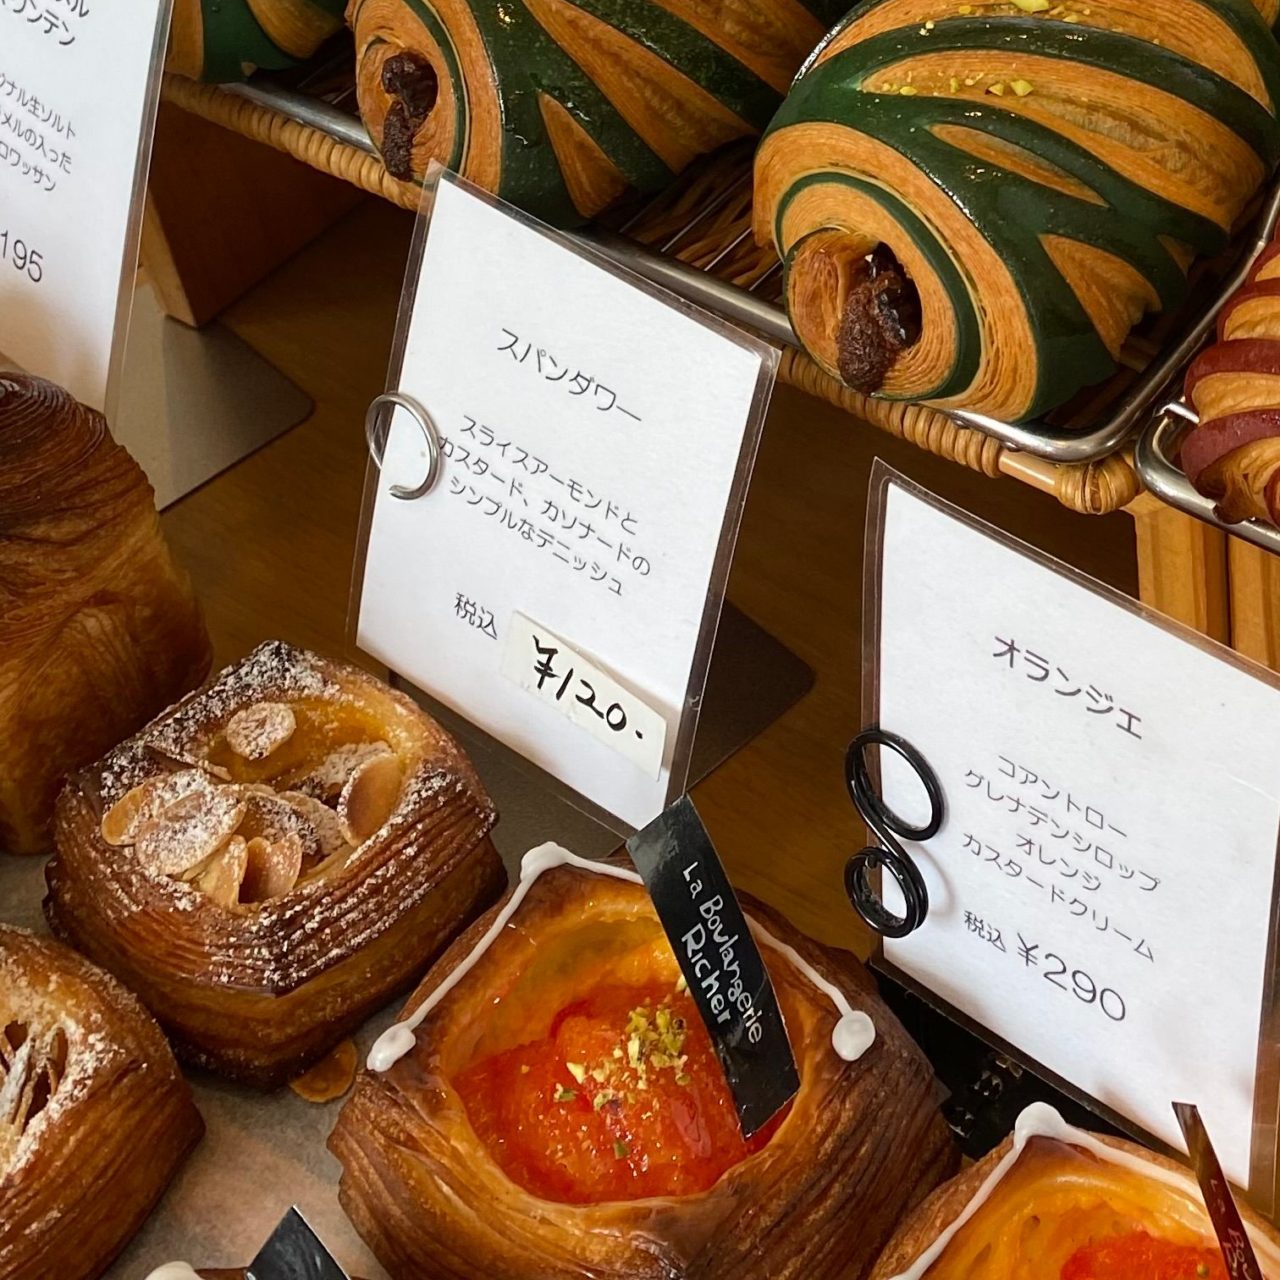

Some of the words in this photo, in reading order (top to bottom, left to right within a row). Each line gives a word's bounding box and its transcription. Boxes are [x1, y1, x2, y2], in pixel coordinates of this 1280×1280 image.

[497, 329, 642, 422] スパンダワー
[460, 415, 638, 535] スライスアーモンドと
[449, 476, 623, 596] シンプルなデニッシュ
[454, 592, 498, 640] 税込
[965, 770, 1162, 891] グレナデンシロップ
[998, 755, 1128, 837] コアントロー
[682, 861, 703, 899] La
[962, 834, 1154, 963] カスタードクリーム
[1015, 837, 1101, 892] オレンジ
[964, 910, 1008, 954] 税込
[1017, 932, 1126, 1021] ¥290
